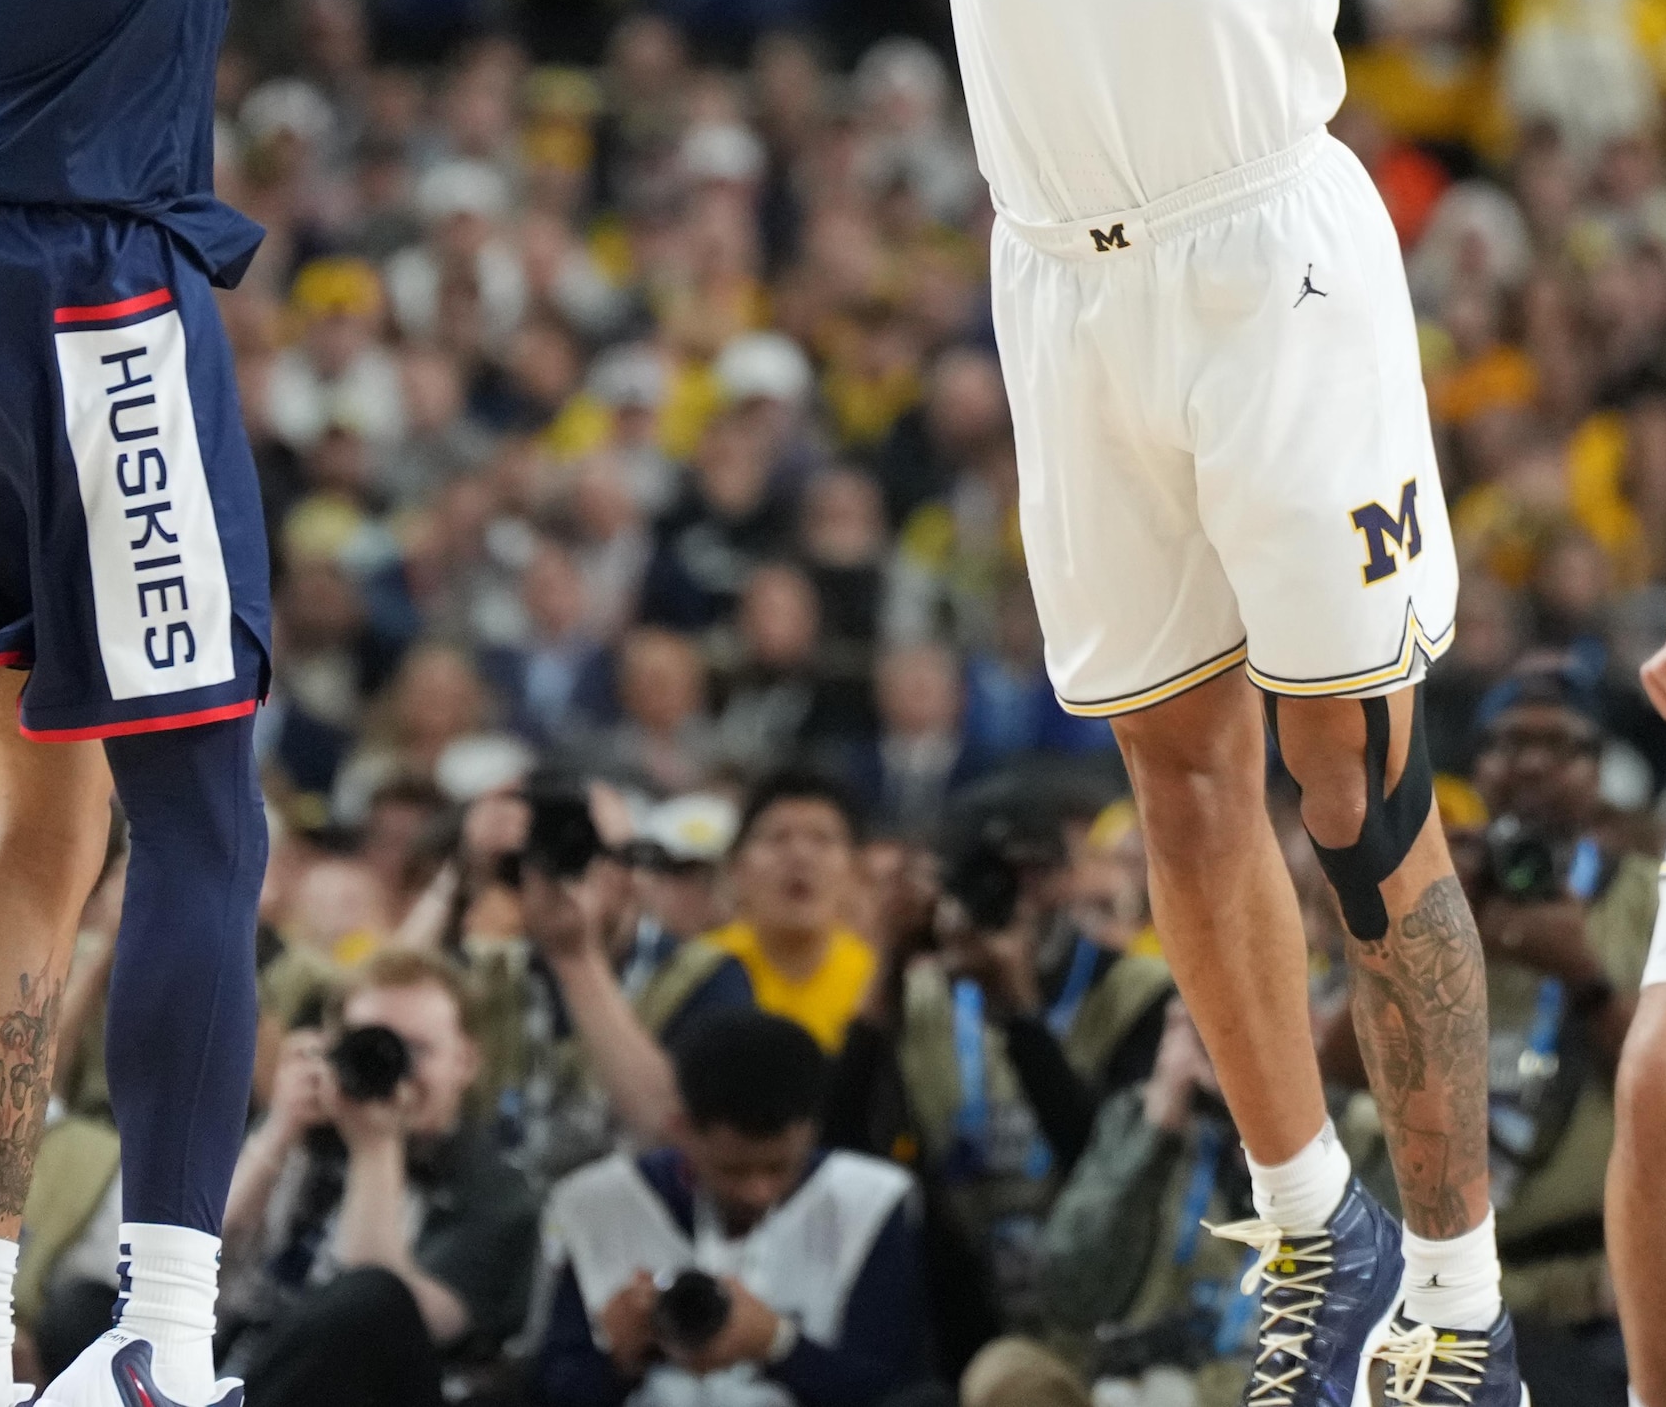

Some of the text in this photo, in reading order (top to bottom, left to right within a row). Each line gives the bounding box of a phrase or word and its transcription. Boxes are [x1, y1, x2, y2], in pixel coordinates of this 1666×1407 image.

[1089, 223, 1131, 252] M
[100, 346, 196, 670] HUSKIES
[1347, 476, 1423, 588] M
